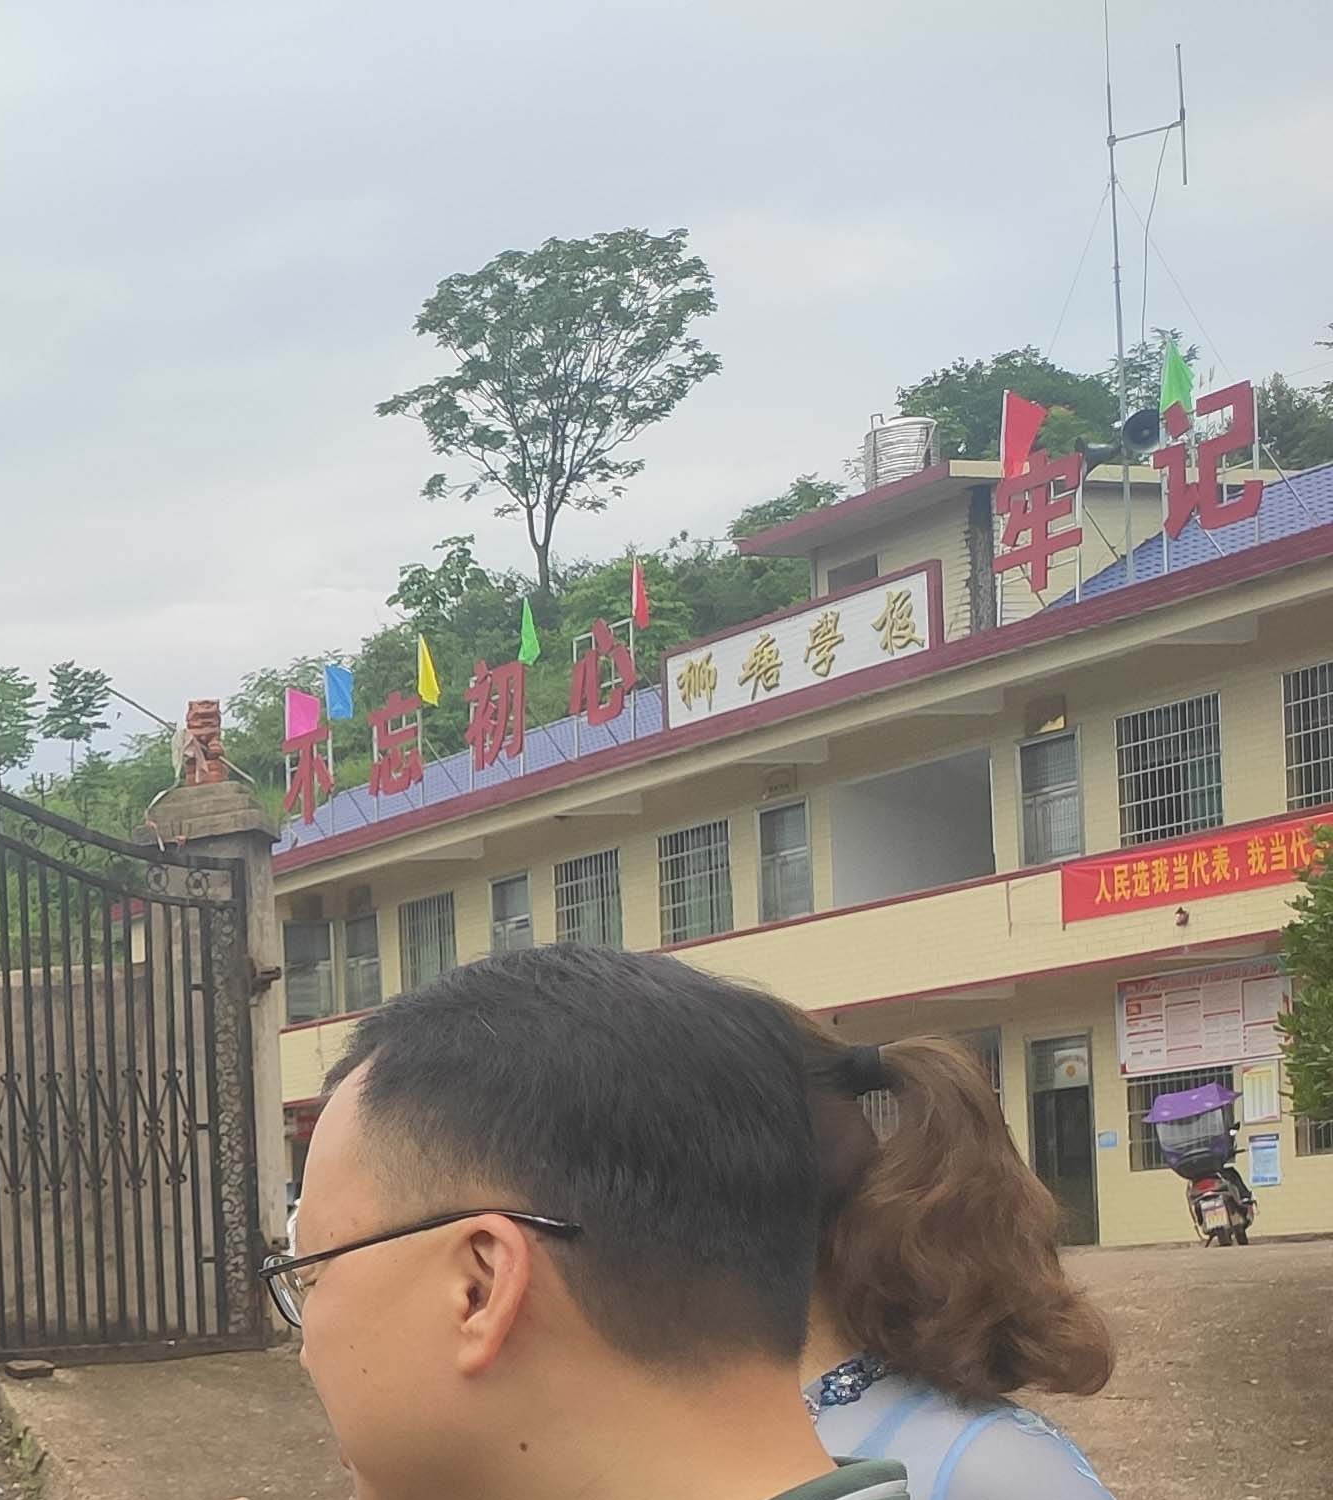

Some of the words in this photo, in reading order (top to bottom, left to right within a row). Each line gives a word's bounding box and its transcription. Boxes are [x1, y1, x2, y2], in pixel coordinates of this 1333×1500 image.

[282, 617, 638, 826] 不忘初心
[992, 379, 1264, 593] 牢记
[1095, 828, 1325, 905] 人民选我当代表，我当代
